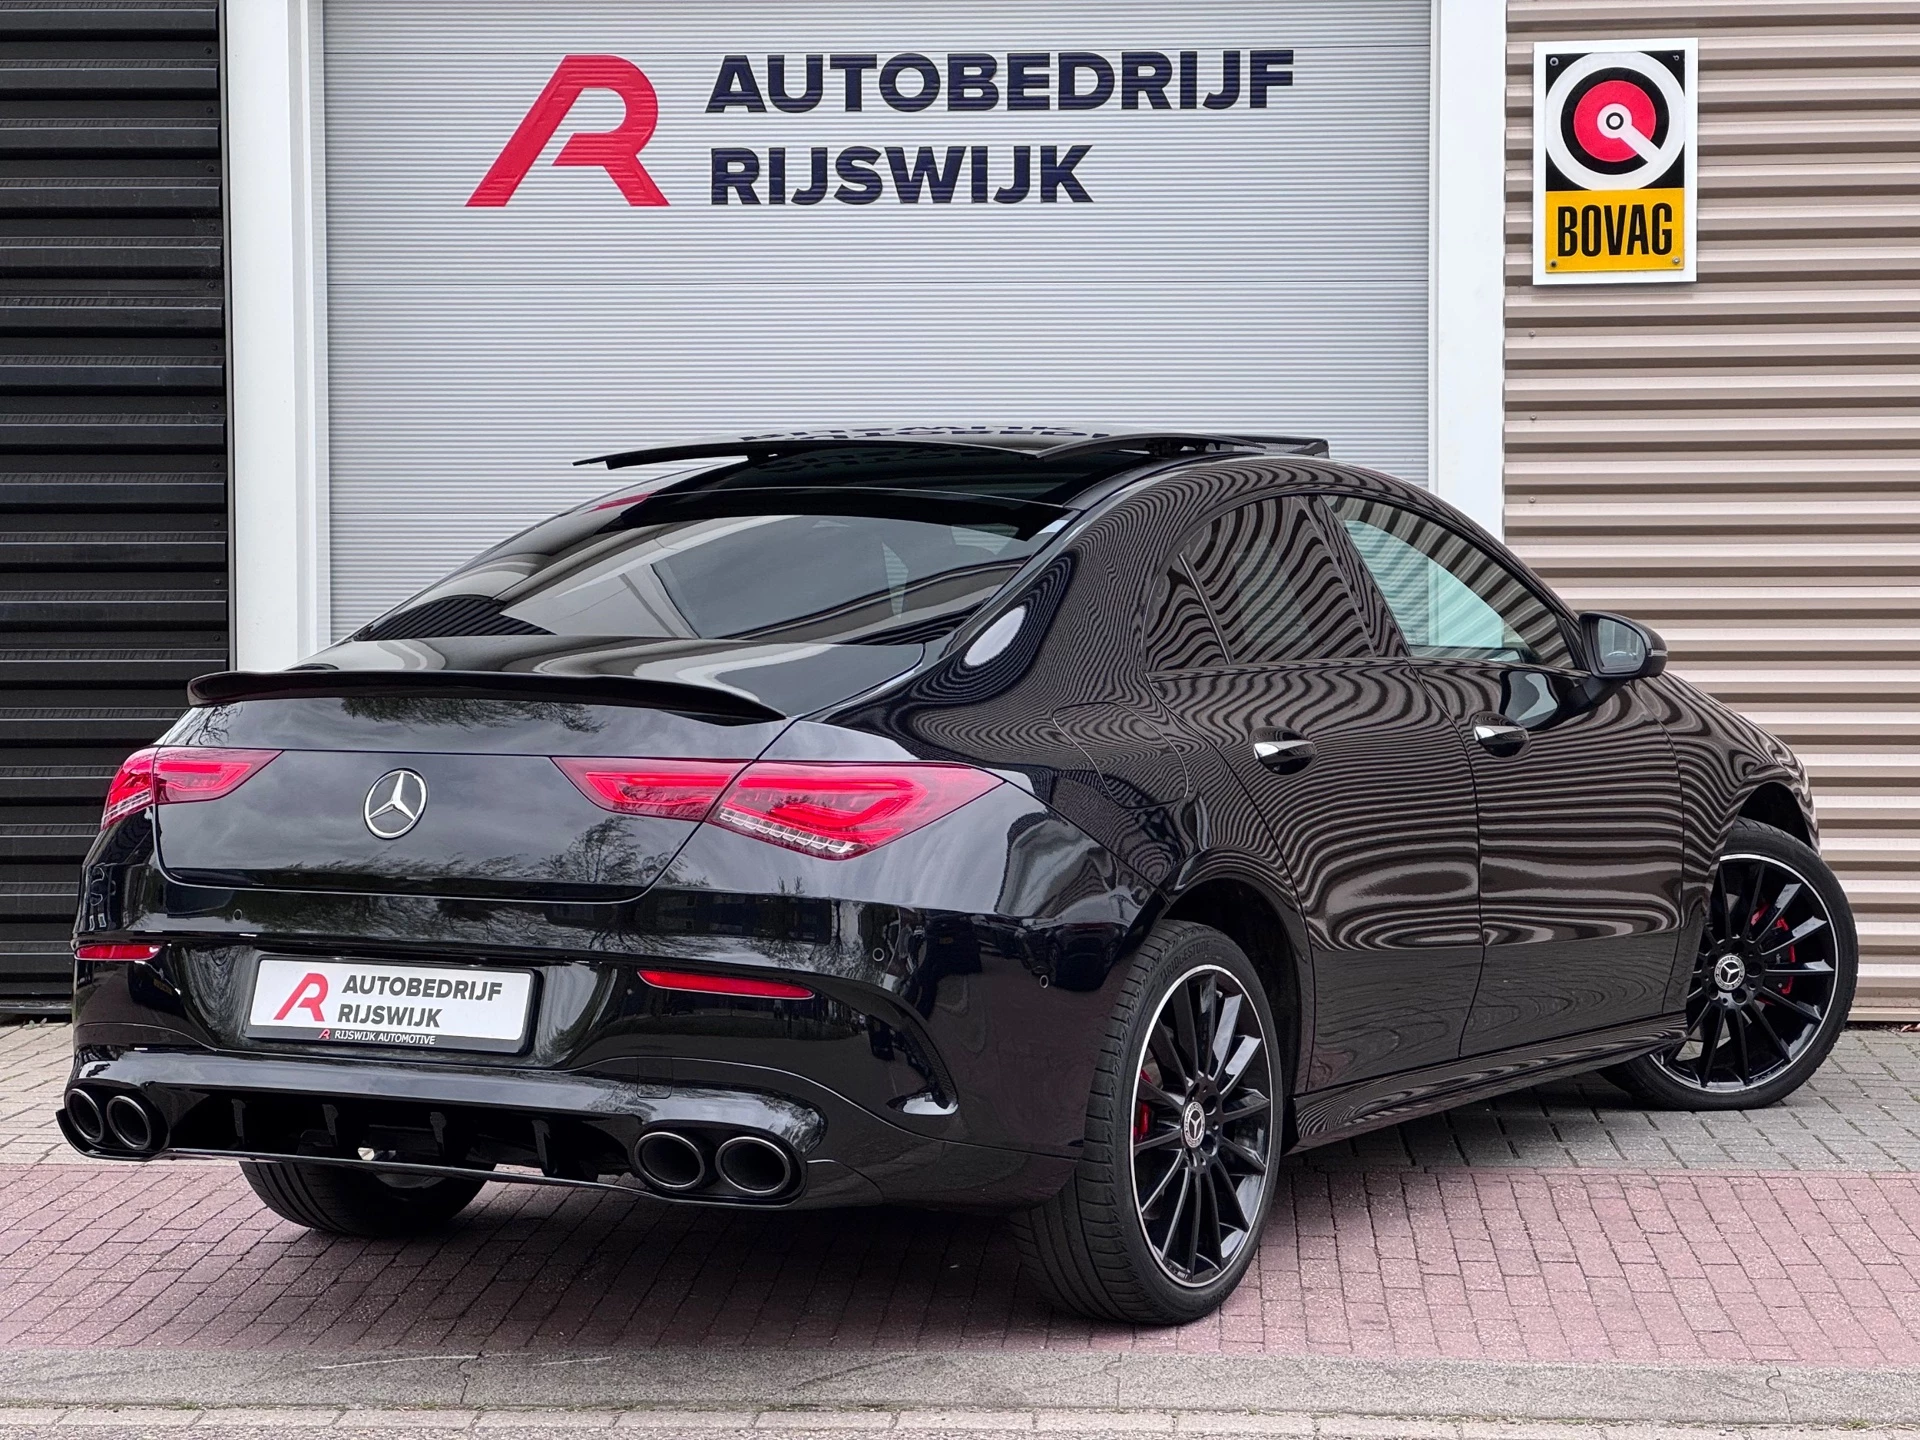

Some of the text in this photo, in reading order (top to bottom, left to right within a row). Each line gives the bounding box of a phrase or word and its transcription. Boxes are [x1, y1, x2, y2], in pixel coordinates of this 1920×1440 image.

[704, 50, 1293, 114] AUTOBEDRIJF
[711, 145, 1093, 206] RIJSWIJK
[1558, 202, 1672, 257] BOVAG
[342, 974, 503, 1001] AUTOBEDRIJF
[338, 1004, 442, 1027] RIJSWIJK
[334, 1030, 377, 1041] RIJSWIJK
[377, 1032, 437, 1045] AUTOMOTIVE
